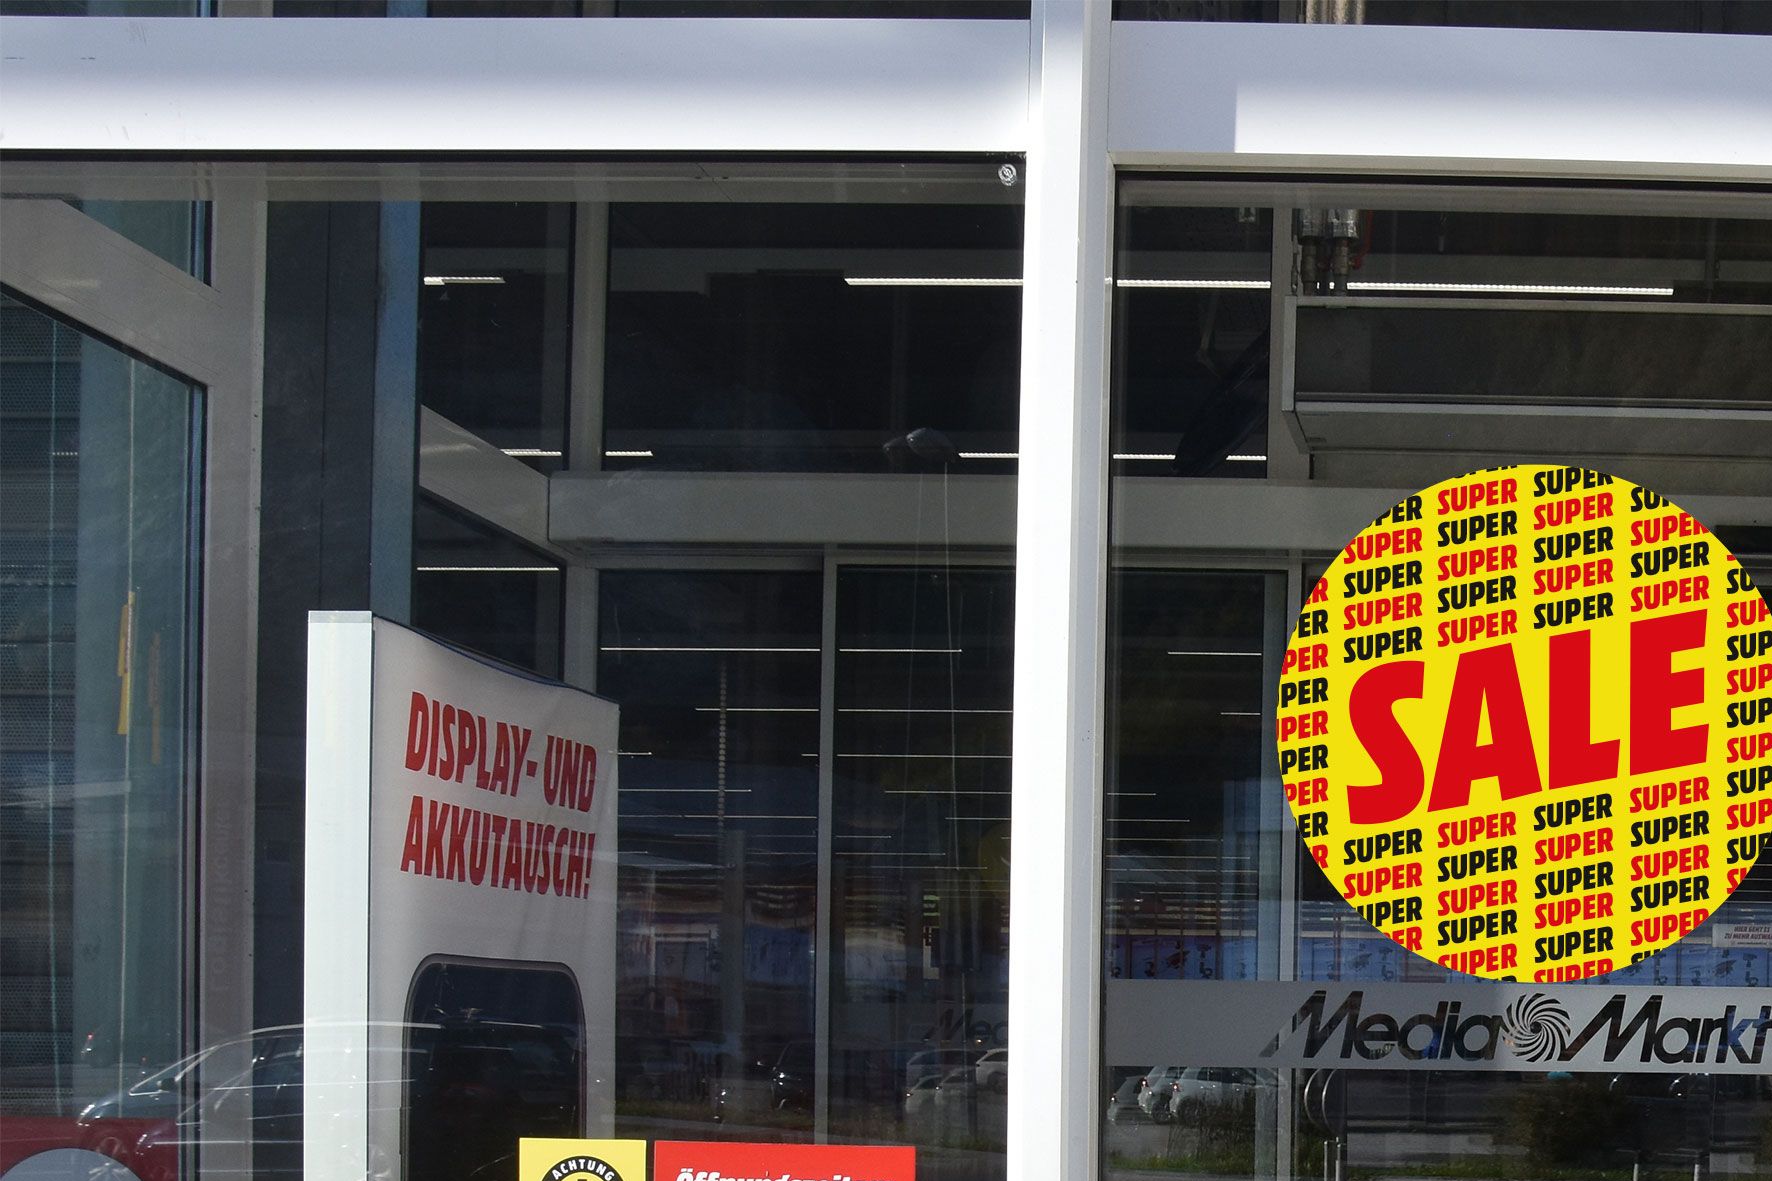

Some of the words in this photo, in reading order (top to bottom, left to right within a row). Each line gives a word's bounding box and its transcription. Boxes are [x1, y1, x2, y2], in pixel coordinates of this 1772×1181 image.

[1438, 511, 1517, 547] SUPER
[1534, 493, 1613, 530] SUPER
[1438, 545, 1517, 581] SUPER
[1534, 527, 1613, 563] SUPER
[1631, 542, 1709, 578] SUPER
[1344, 561, 1422, 598] SUPER
[1438, 576, 1516, 613] SUPER
[1534, 559, 1612, 595] SUPER
[1631, 576, 1708, 612] SUPER
[1344, 593, 1422, 630] SUPER
[1438, 610, 1517, 647] SUPER
[1344, 627, 1422, 663] SUPER
[1346, 609, 1710, 825] SALE
[404, 691, 538, 797] DISPLAY-
[543, 735, 597, 813] UND
[1438, 812, 1516, 848] SUPER
[1534, 794, 1612, 831] SUPER
[1631, 811, 1709, 847] SUPER
[400, 795, 596, 900] AKKUTAUSCH!
[1344, 829, 1422, 865] SUPER
[1438, 846, 1517, 882] SUPER
[1535, 828, 1613, 864] SUPER
[1631, 845, 1709, 881] SUPER
[1344, 863, 1422, 898] SUPER
[1438, 880, 1516, 916] SUPER
[1535, 862, 1613, 899] SUPER
[1631, 876, 1709, 912] SUPER
[1438, 910, 1517, 946] SUPER
[1535, 893, 1613, 928] SUPER
[1535, 927, 1613, 963] SUPER
[1259, 989, 1501, 1060] Media
[552, 1159, 615, 1181] ACHTUNG
